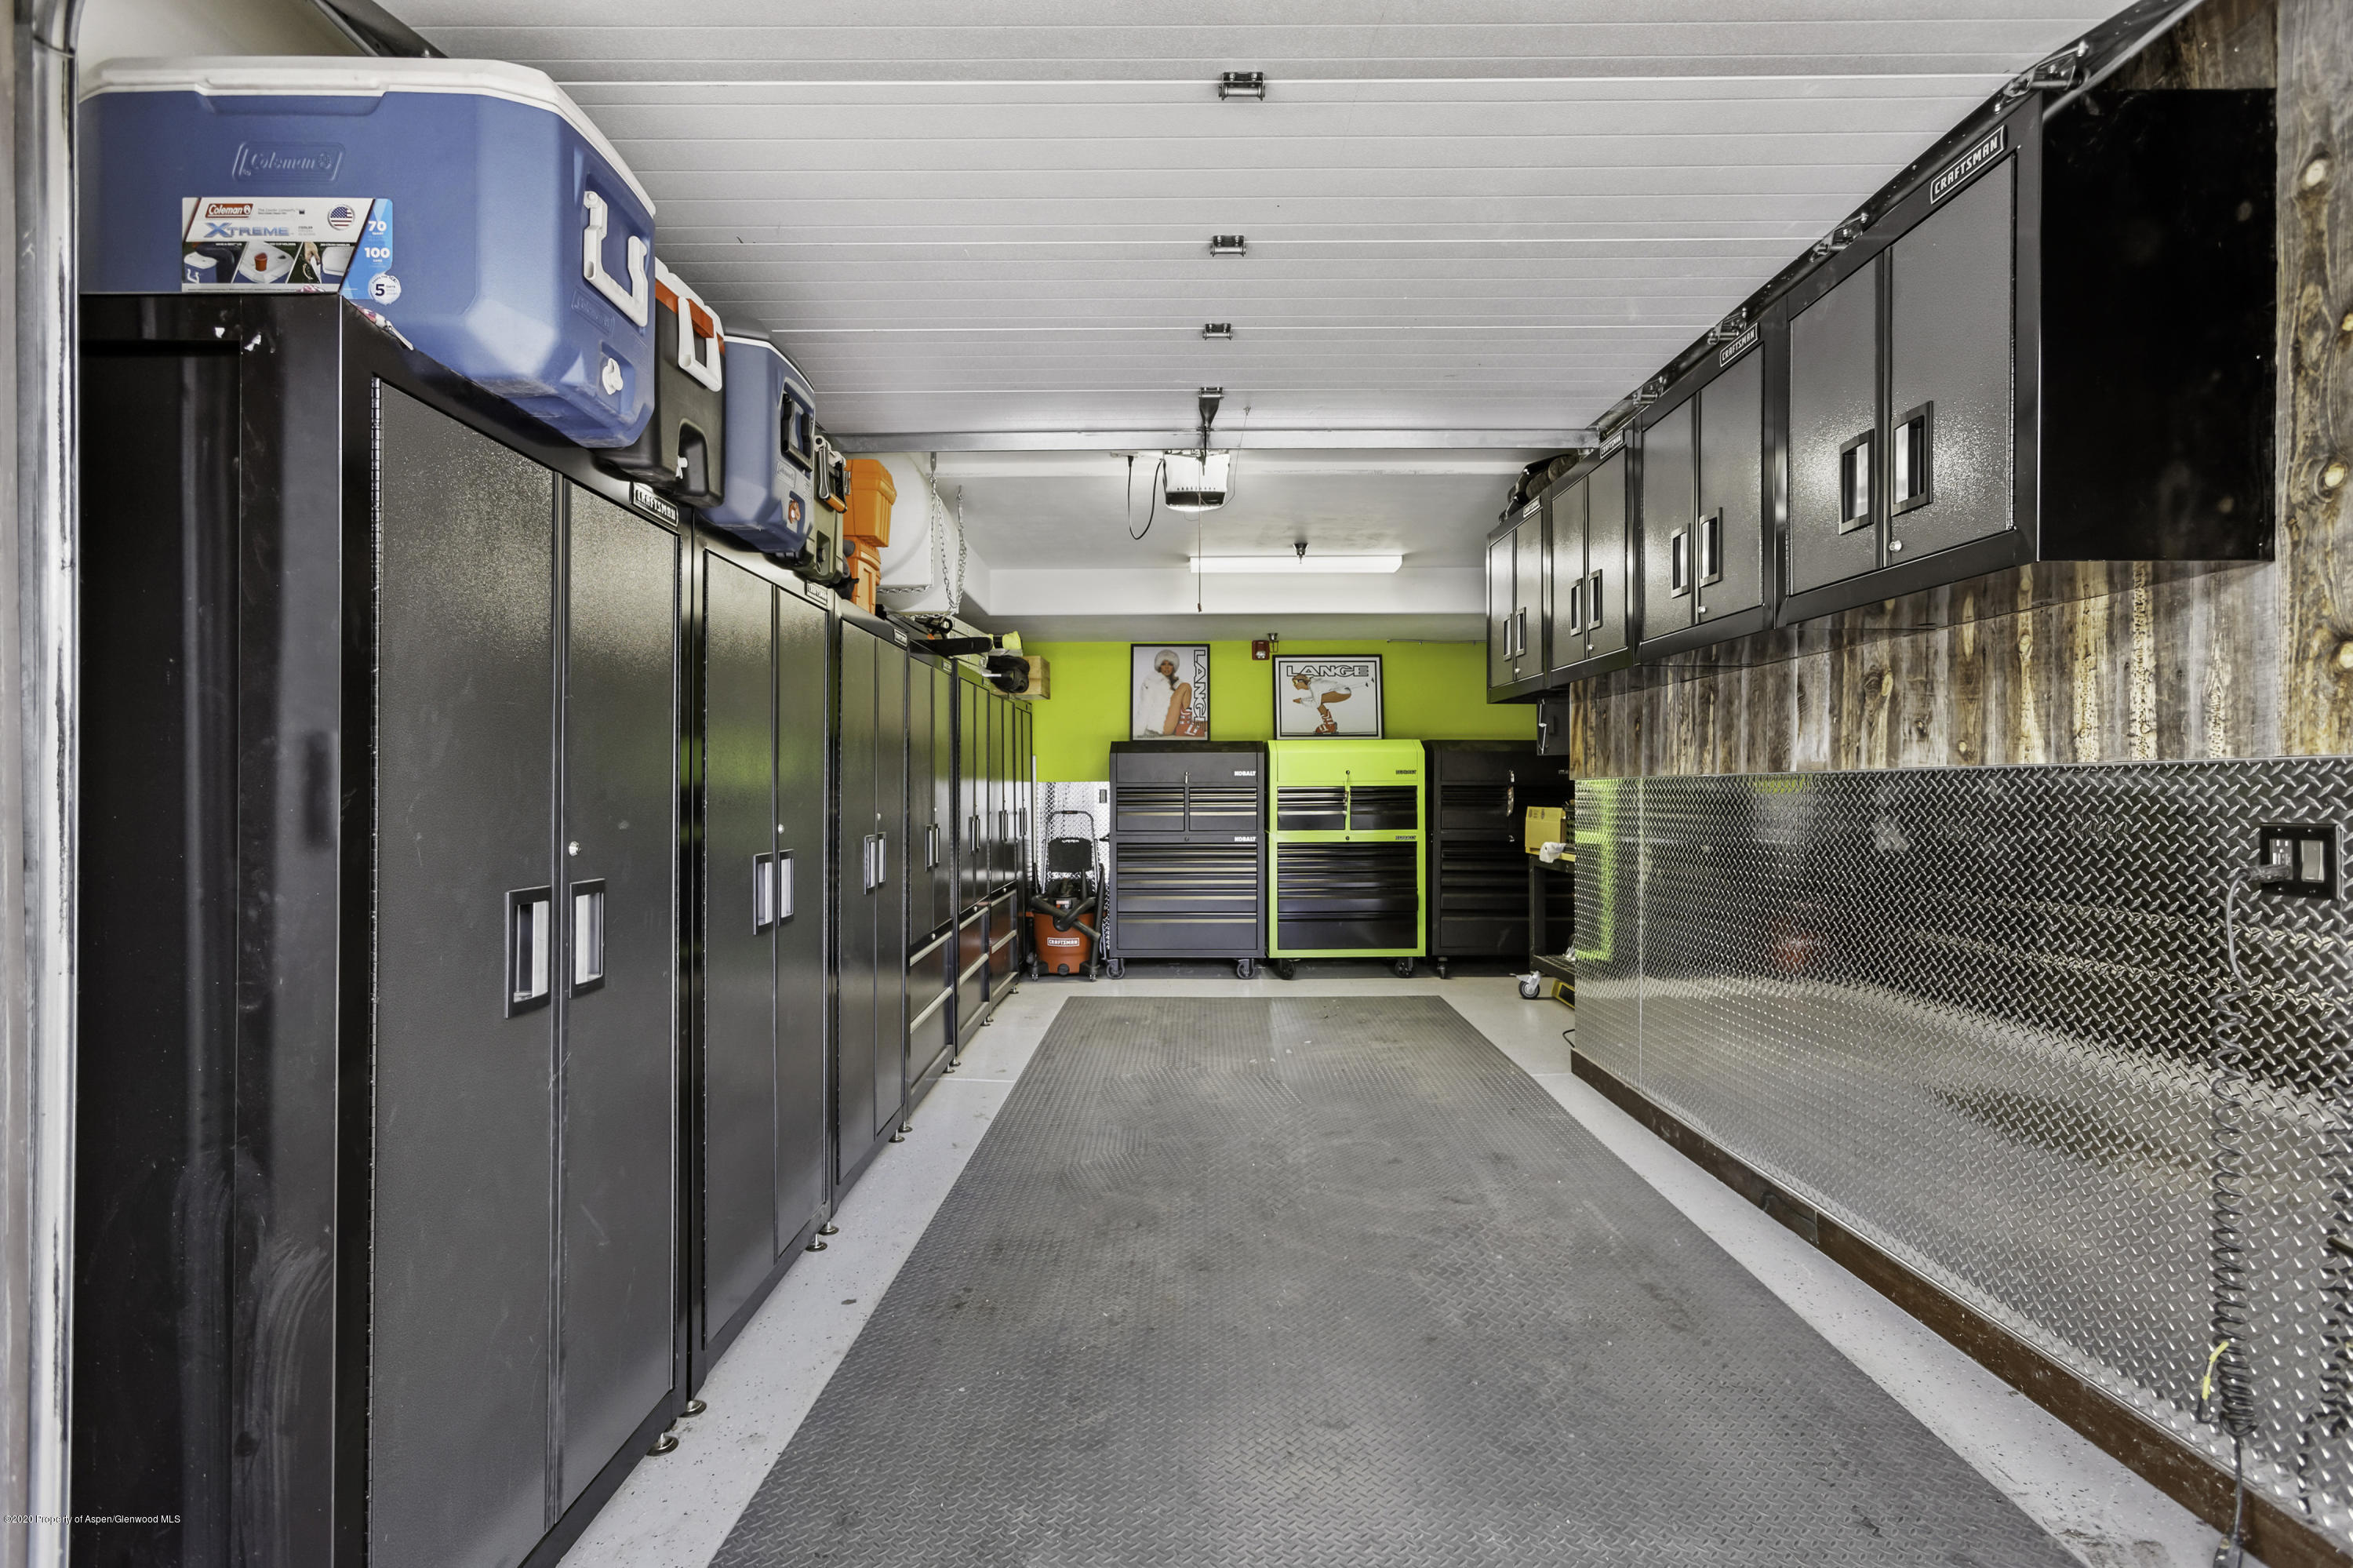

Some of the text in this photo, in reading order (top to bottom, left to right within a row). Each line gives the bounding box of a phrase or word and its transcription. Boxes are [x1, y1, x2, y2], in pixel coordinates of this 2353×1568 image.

[251, 152, 315, 170] Coleman
[1934, 136, 1998, 195] CRAFTSMAN
[209, 204, 242, 214] Coleman
[368, 220, 387, 231] 70
[364, 247, 391, 258] 100
[375, 283, 385, 297] 5
[1722, 329, 1755, 361] CRAFTSMAN
[635, 489, 676, 521] CRAFTSMAN
[1286, 665, 1369, 677] LANGE
